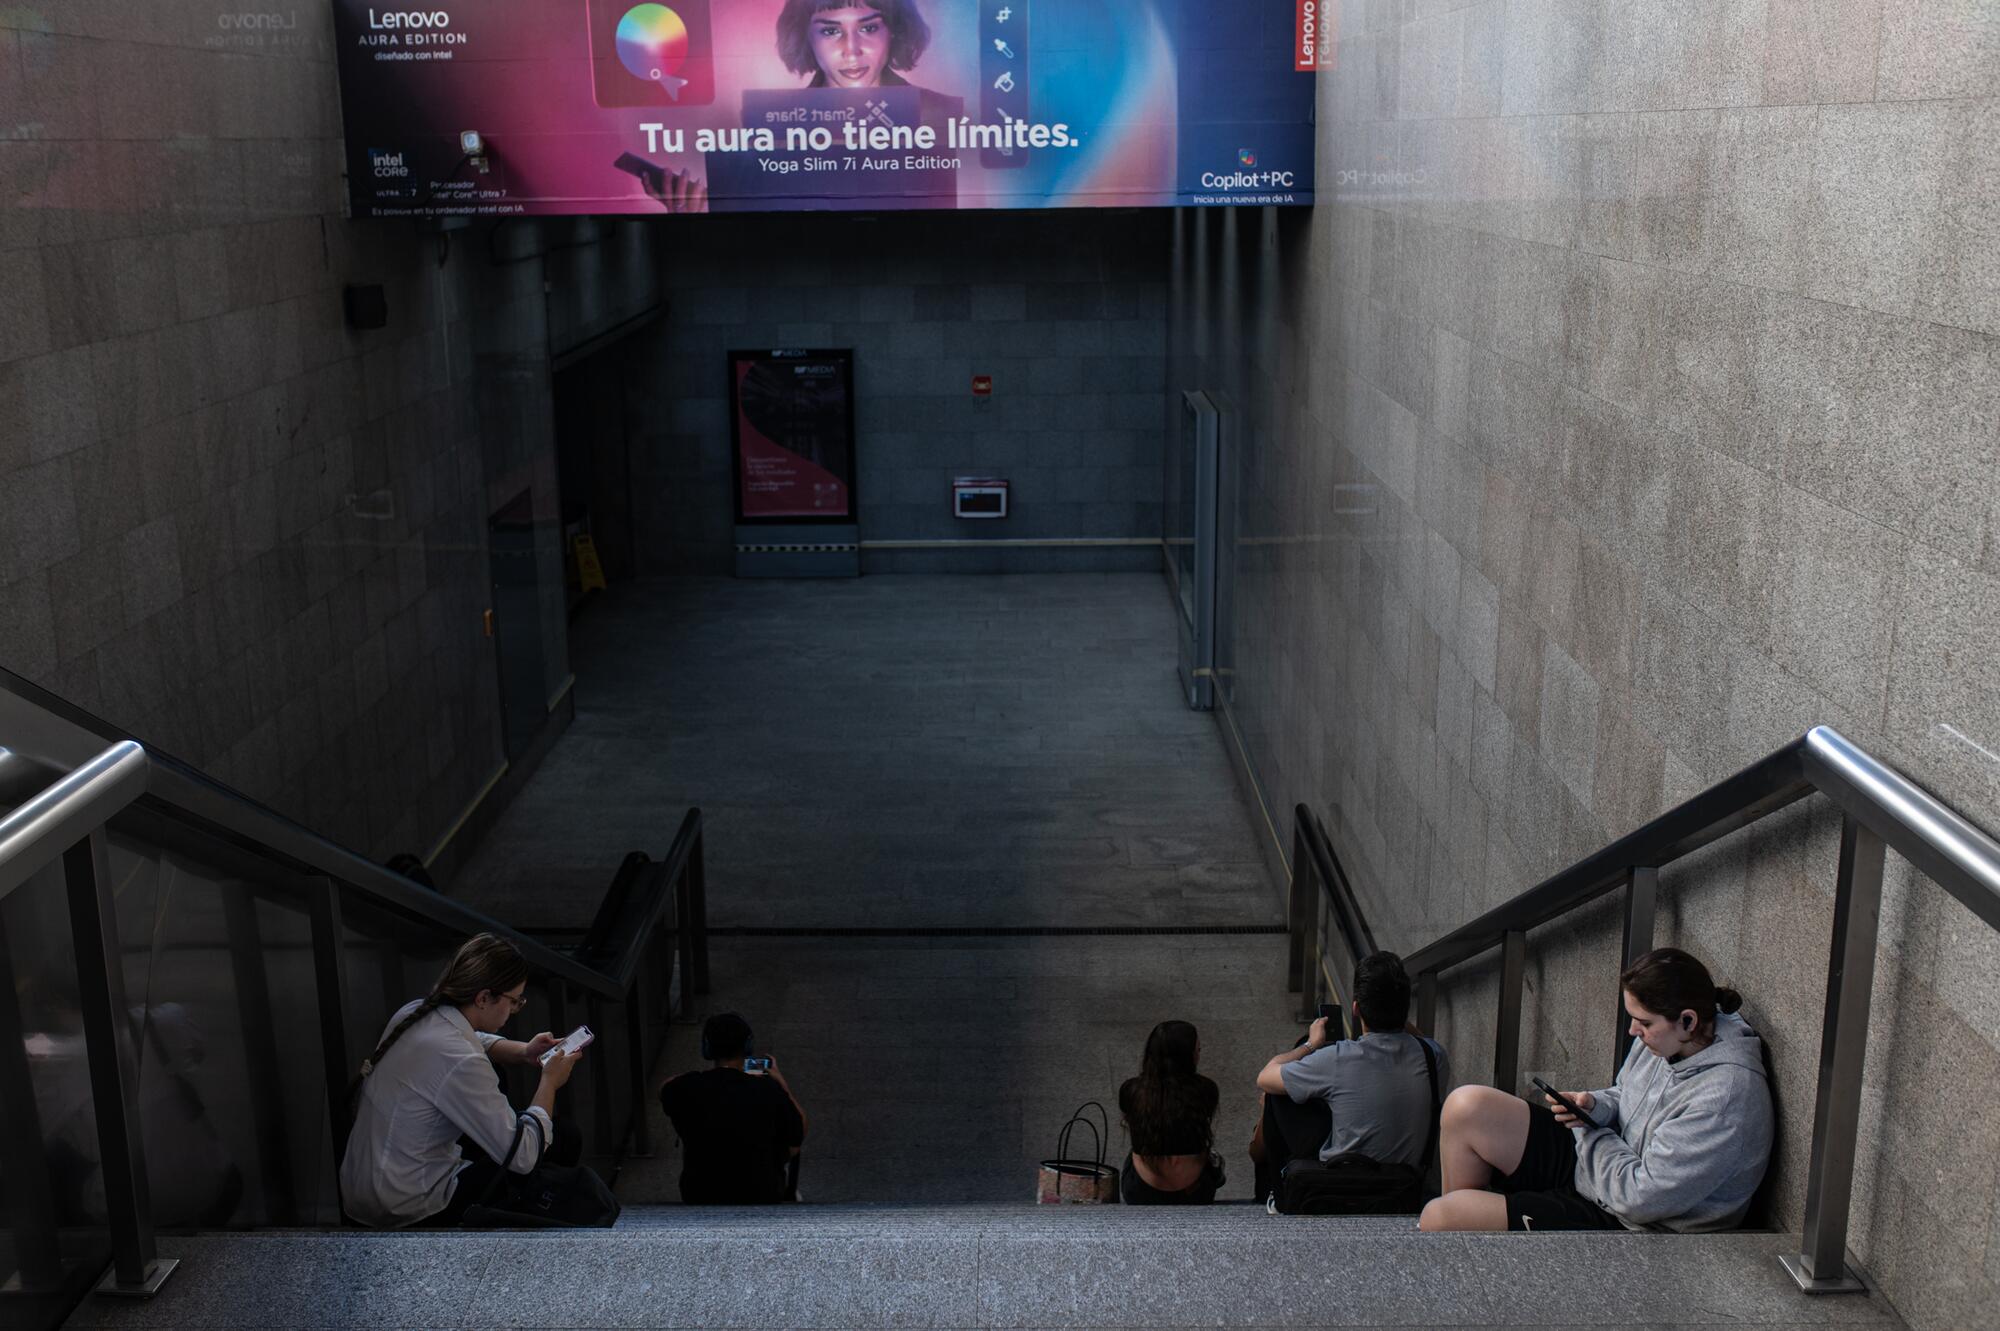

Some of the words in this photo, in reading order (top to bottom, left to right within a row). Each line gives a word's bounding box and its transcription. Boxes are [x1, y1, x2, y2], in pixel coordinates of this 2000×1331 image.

[369, 8, 450, 29] Lenovo
[358, 34, 399, 46] AURA
[405, 33, 467, 45] EDITION
[1300, 1, 1315, 65] Lenovo
[374, 50, 413, 61] diseñado
[415, 51, 432, 60] con
[639, 123, 684, 153] Tu
[695, 127, 774, 153] aura
[786, 126, 832, 151] no
[843, 119, 936, 150] tiene
[948, 116, 1079, 148] límites.
[373, 152, 403, 167] intel
[758, 158, 799, 174] Yoga
[804, 157, 838, 171] Slim
[843, 157, 856, 170] 7i
[861, 156, 899, 170] Aura
[905, 155, 961, 169] Edition
[1201, 171, 1294, 190] Copilot+PC
[479, 190, 499, 198] Ultra
[501, 189, 507, 197] 7
[1193, 195, 1214, 204] Inicia
[1232, 195, 1256, 203] nueva
[1257, 195, 1271, 203] era
[1272, 194, 1283, 203] de
[1284, 194, 1294, 203] IA
[498, 205, 514, 213] con
